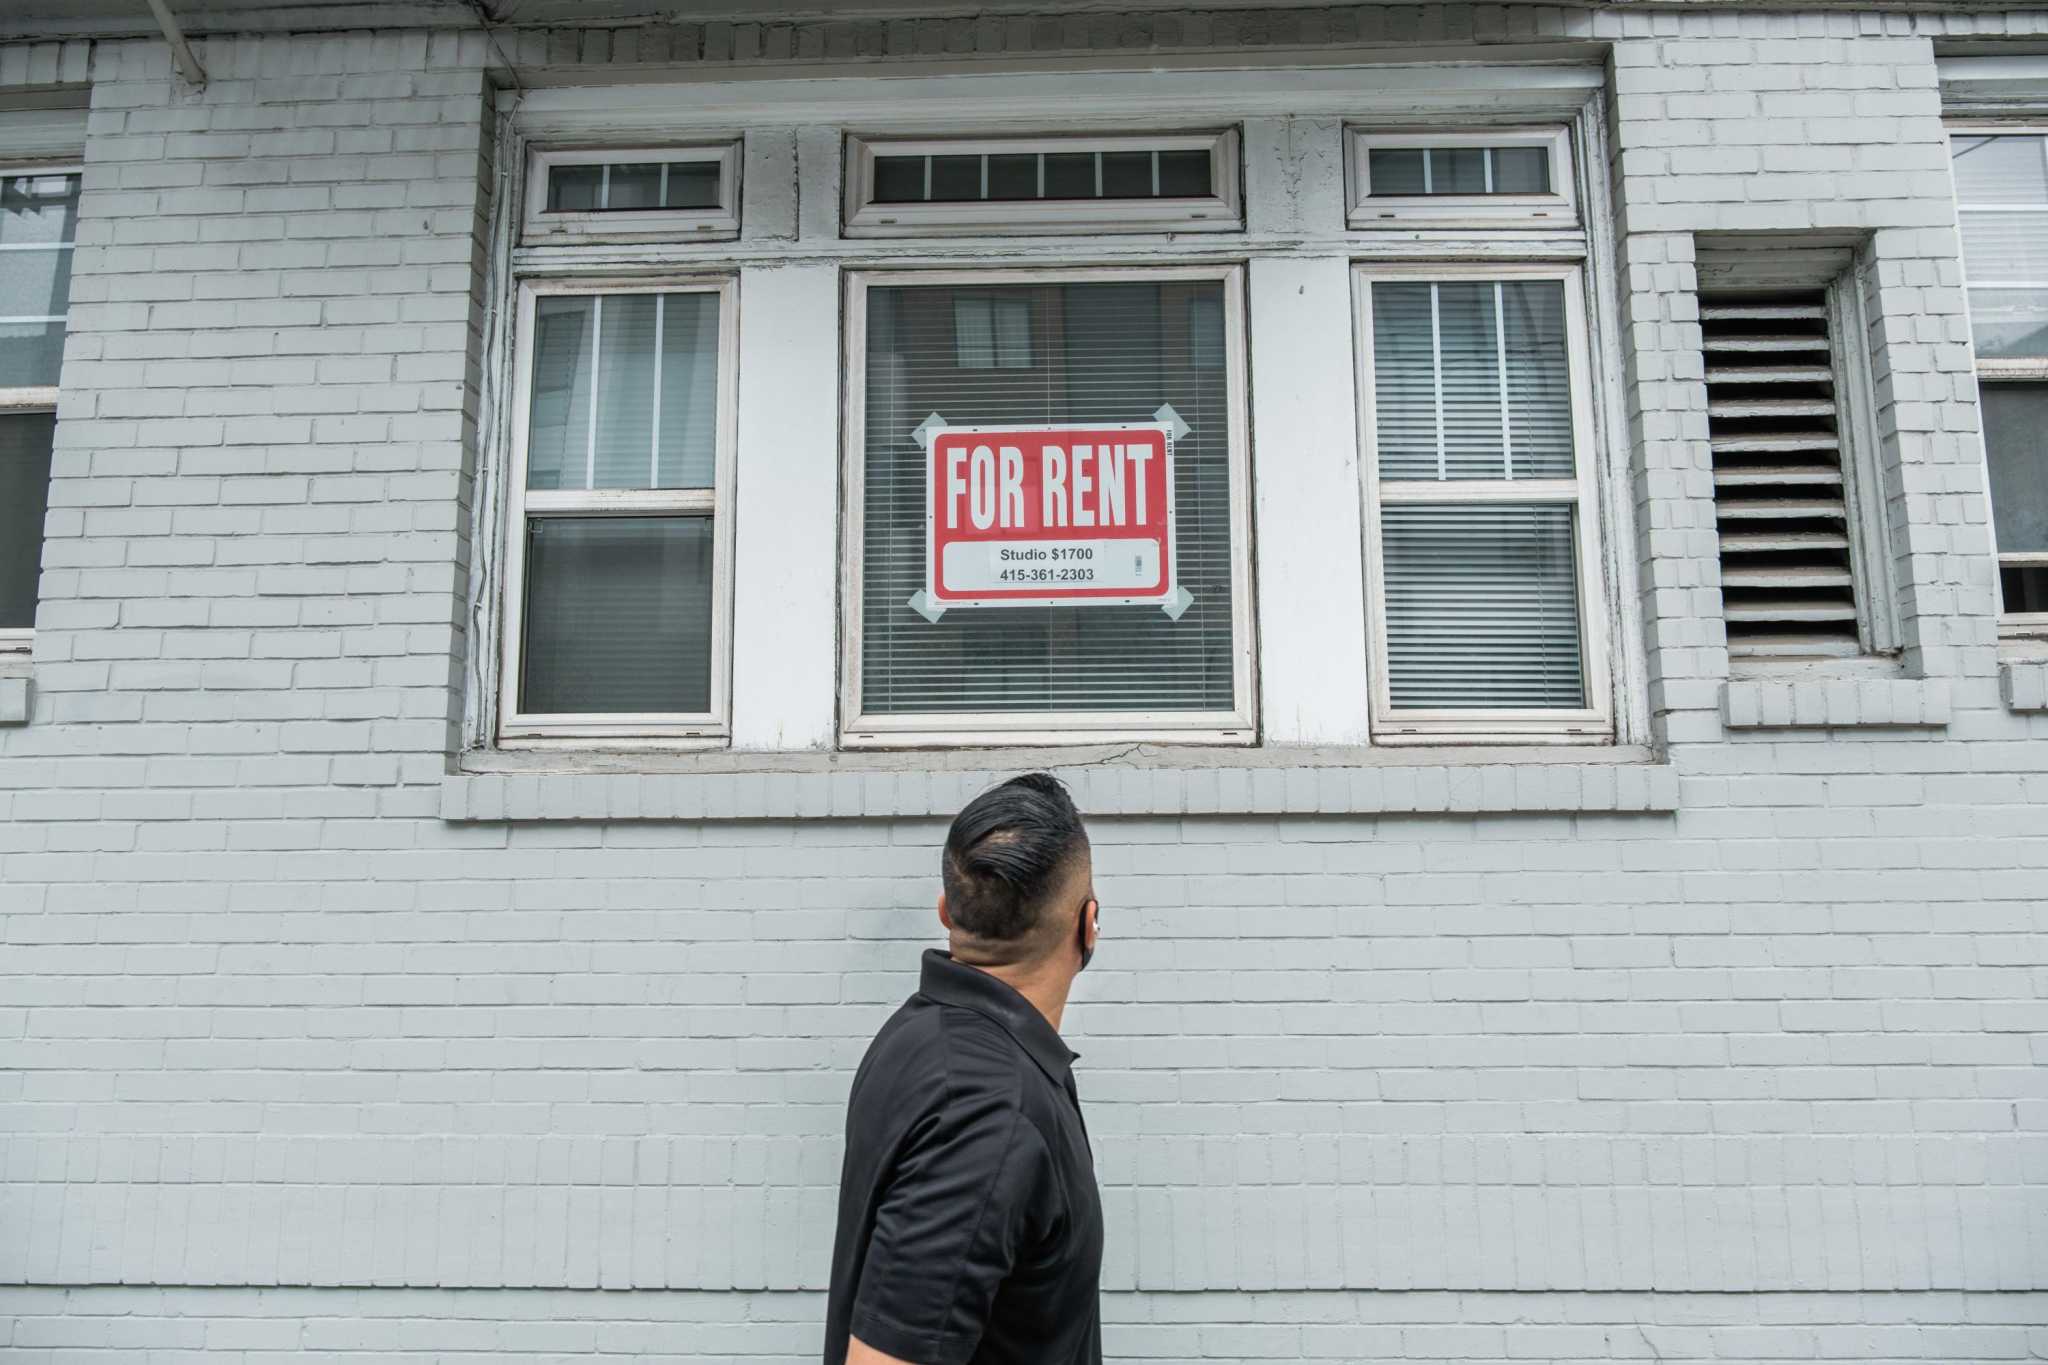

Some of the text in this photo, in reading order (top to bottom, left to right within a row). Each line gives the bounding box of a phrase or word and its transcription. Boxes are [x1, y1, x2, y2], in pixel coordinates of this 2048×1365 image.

[947, 443, 1153, 530] FOR RENT
[1000, 547, 1093, 561] Studio $1700
[1000, 569, 1094, 581] 415-361-2303
